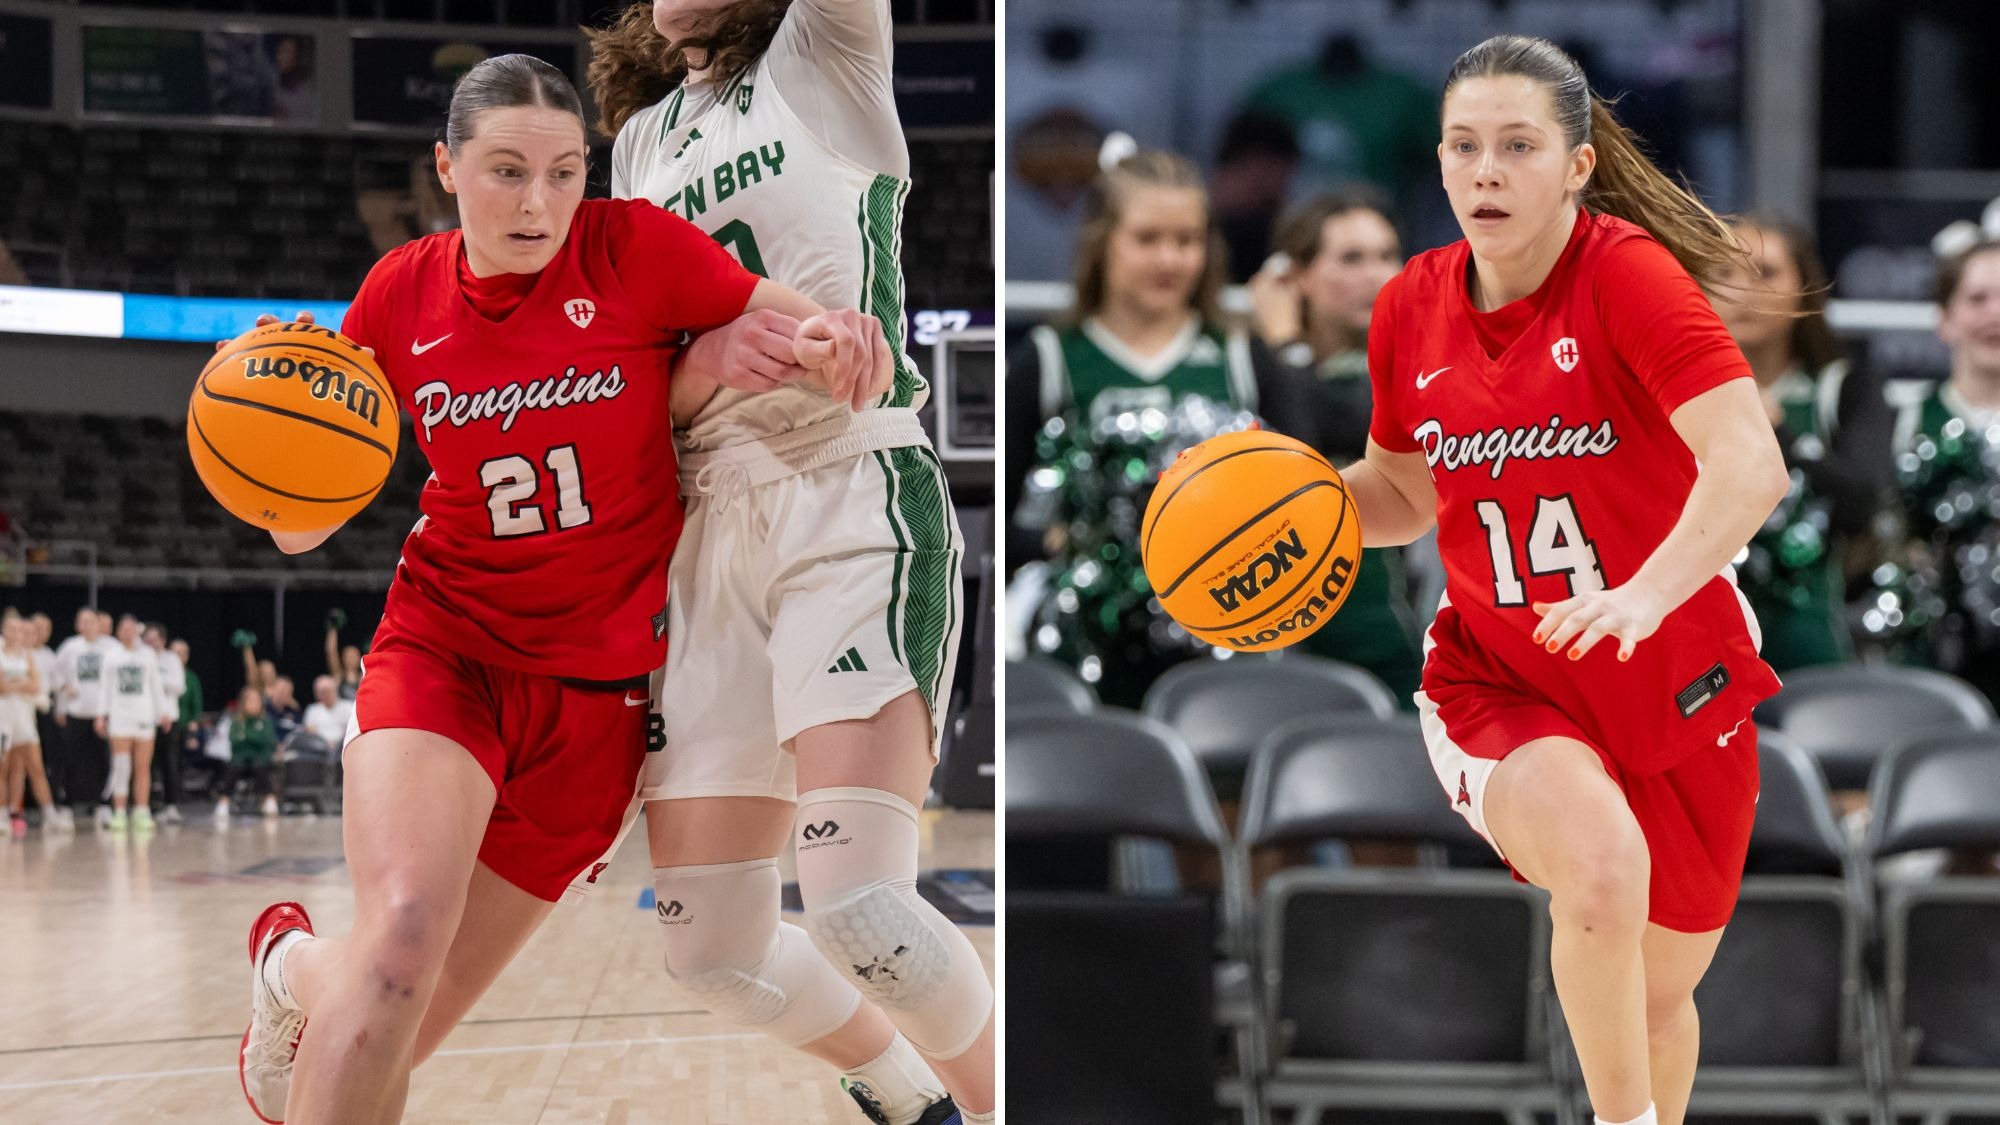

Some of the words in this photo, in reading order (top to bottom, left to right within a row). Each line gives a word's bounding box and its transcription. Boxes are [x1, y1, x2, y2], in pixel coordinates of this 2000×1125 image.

[713, 140, 786, 203] BAY
[244, 356, 380, 428] Wilson
[414, 364, 626, 442] Penguins
[1413, 414, 1620, 482] Penguins
[477, 442, 593, 540] 21
[1202, 570, 1226, 585] BALL
[1208, 528, 1307, 613] NCAA
[1227, 552, 1253, 573] GAME
[1474, 492, 1609, 608] 14
[1226, 556, 1354, 647] Wilson
[1713, 673, 1725, 688] M
